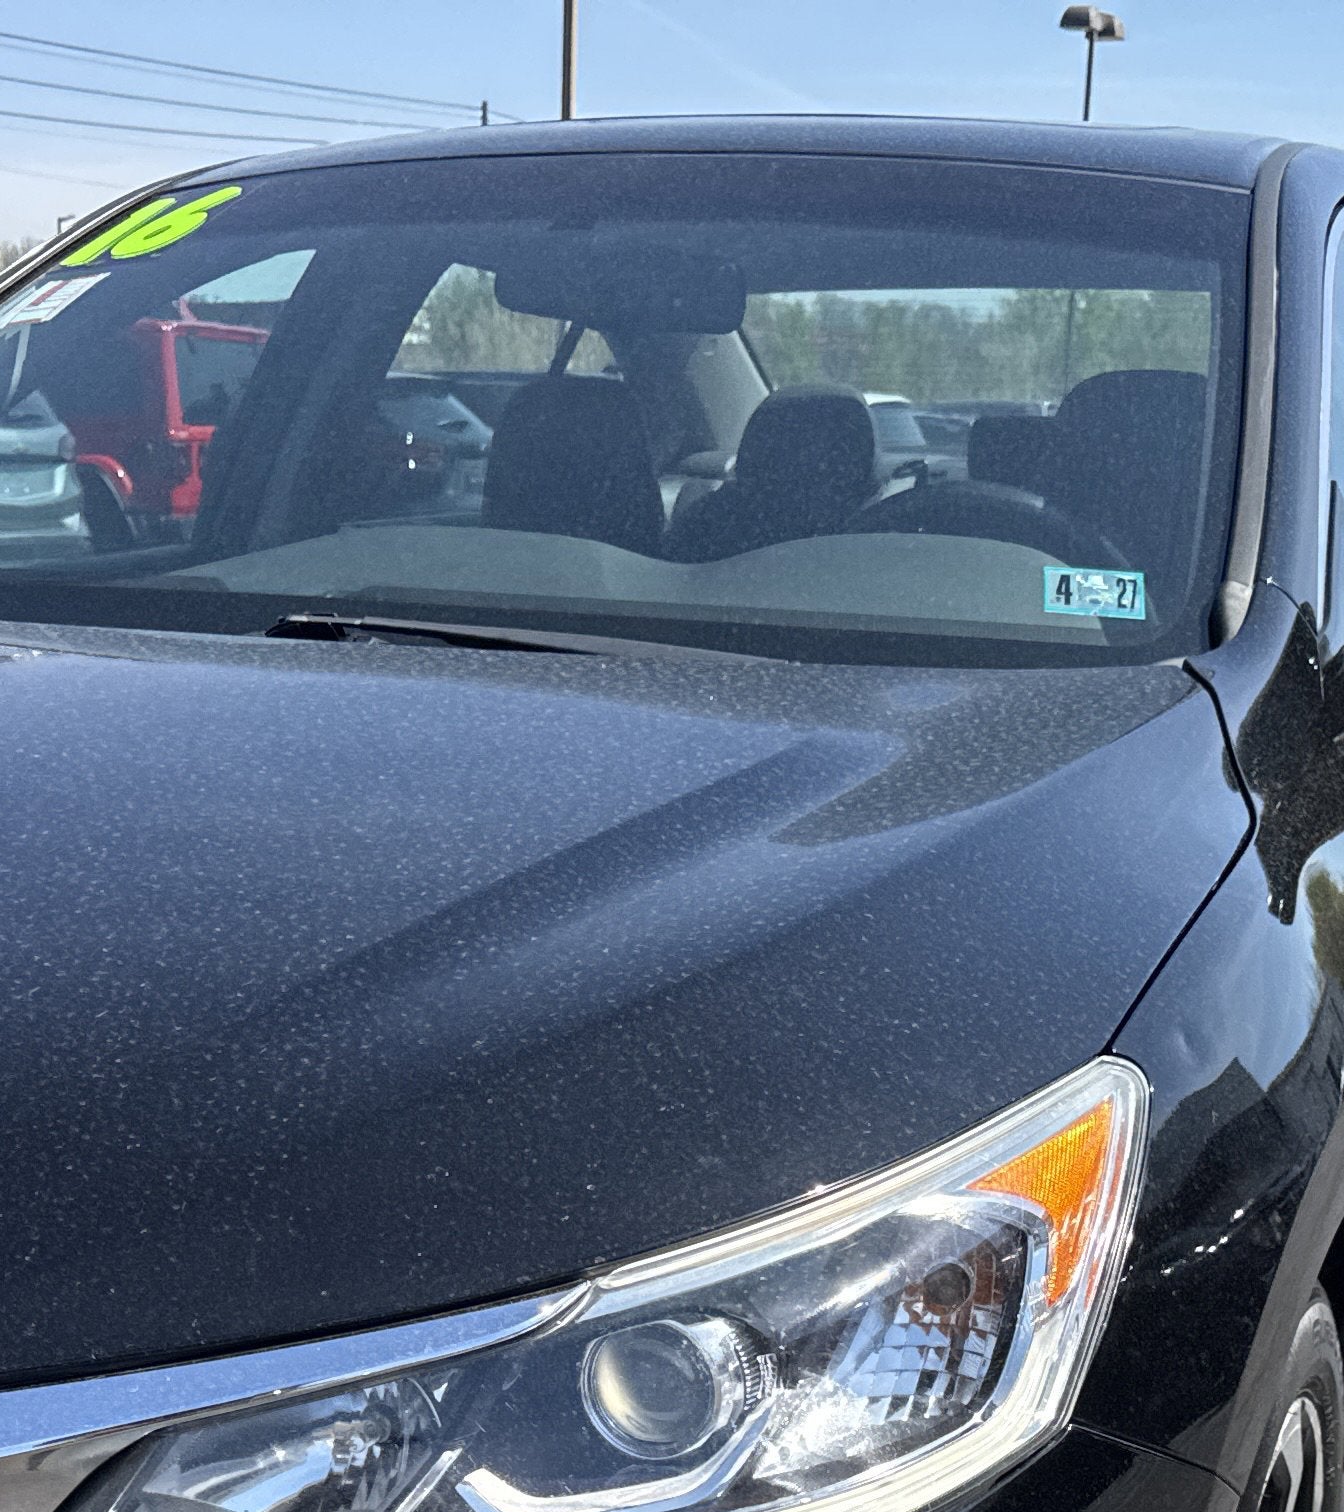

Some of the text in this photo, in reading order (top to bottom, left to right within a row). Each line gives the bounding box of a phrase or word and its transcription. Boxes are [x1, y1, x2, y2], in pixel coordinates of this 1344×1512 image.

[59, 186, 243, 267] 16
[1055, 574, 1138, 610] 4 27
